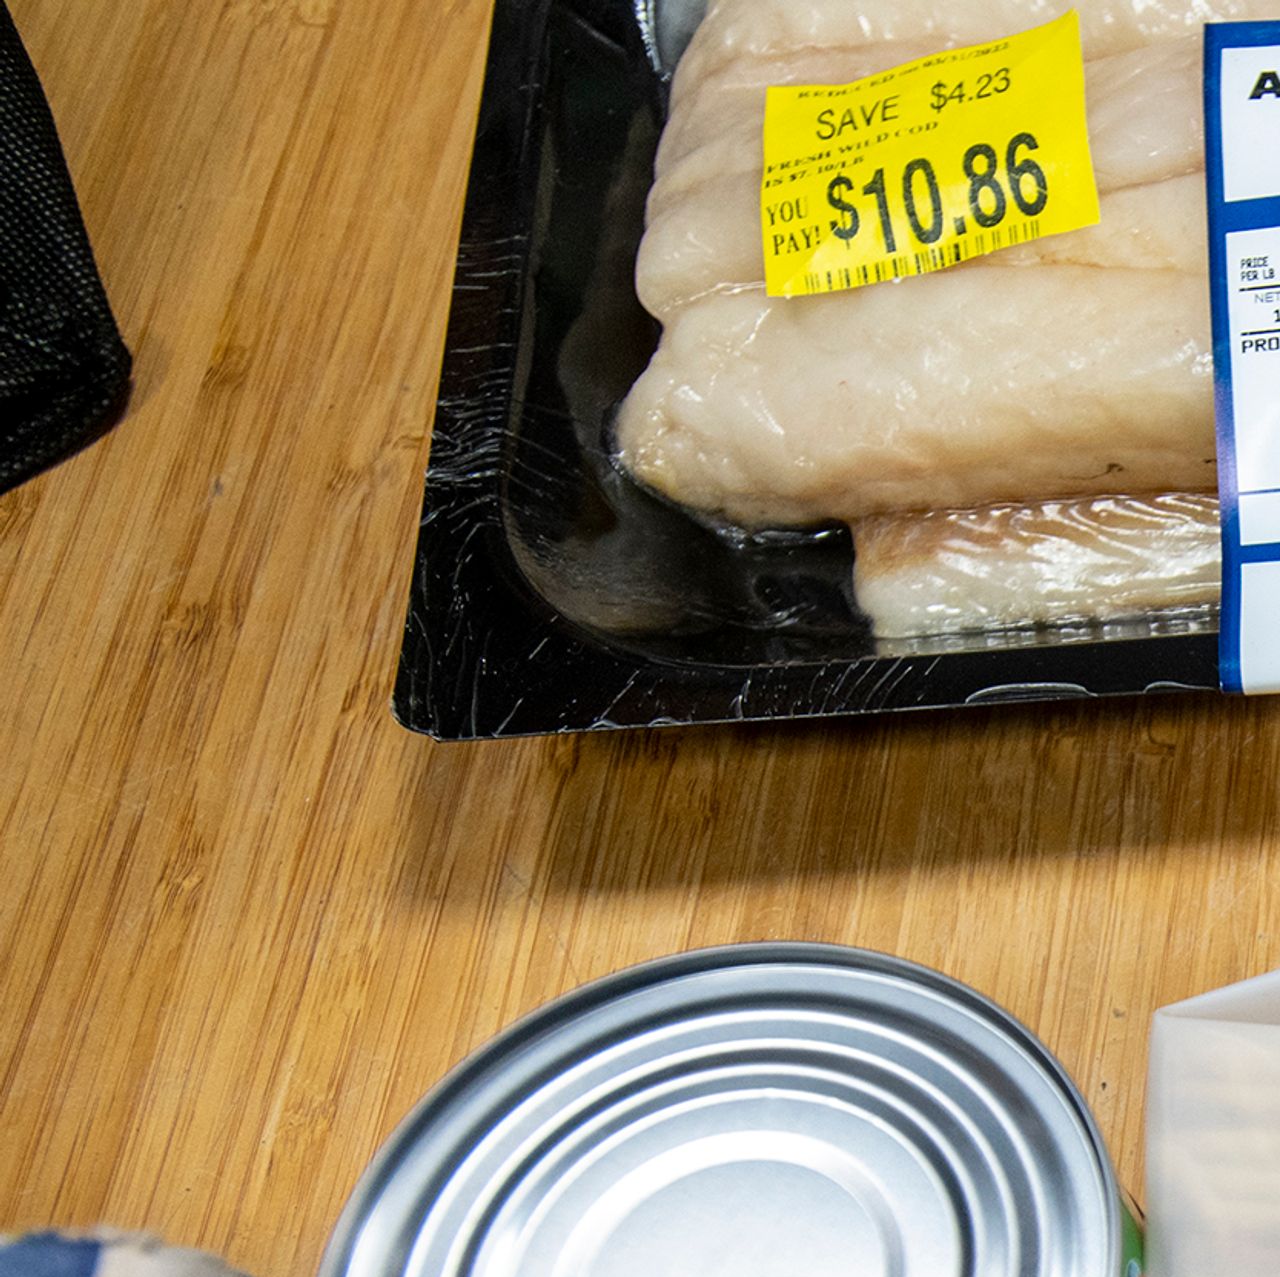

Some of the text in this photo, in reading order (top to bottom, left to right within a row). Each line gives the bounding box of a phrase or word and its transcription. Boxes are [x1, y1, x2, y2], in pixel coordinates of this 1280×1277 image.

[816, 67, 1011, 140] SAVE $4.23
[826, 132, 1048, 255] $10.86
[765, 196, 809, 226] YOU
[772, 225, 821, 257] PAY!
[1240, 256, 1269, 269] PRICE
[1240, 268, 1275, 281] PER LB
